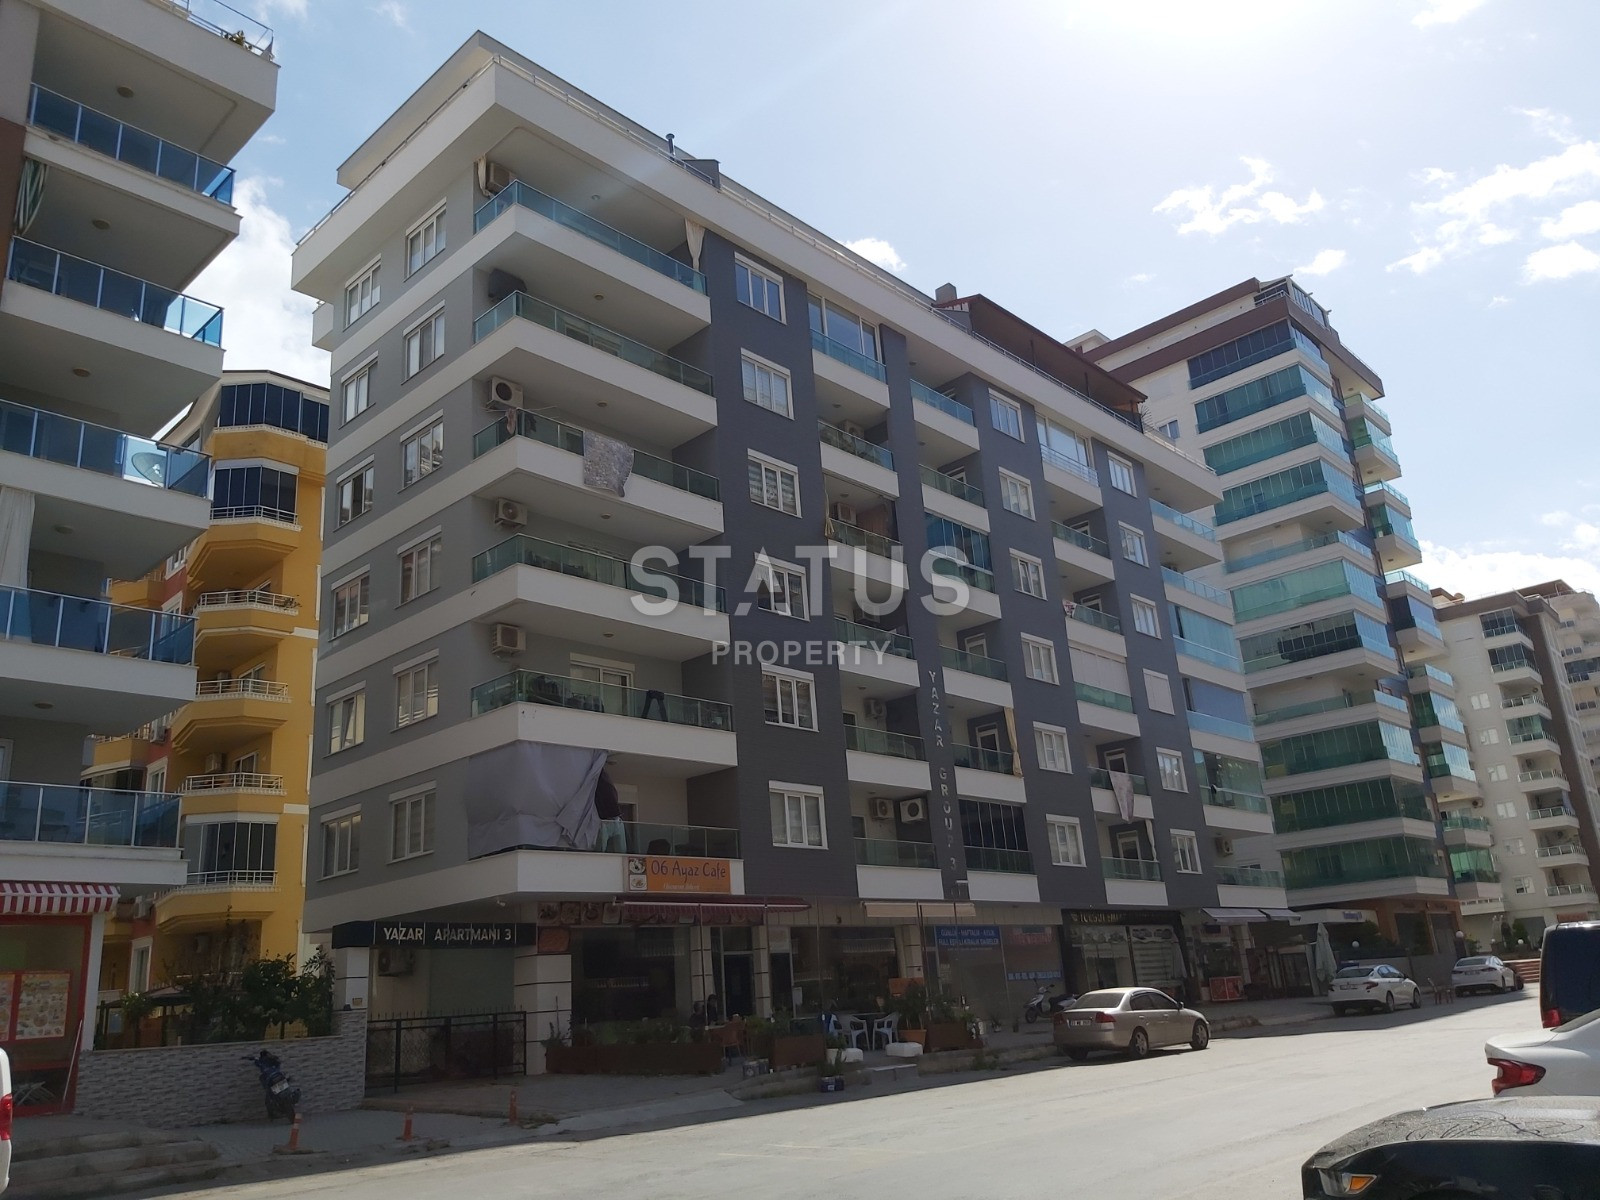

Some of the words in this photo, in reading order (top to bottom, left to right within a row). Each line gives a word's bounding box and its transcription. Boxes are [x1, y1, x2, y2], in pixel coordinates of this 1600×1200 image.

[928, 672, 944, 748] YAZAR
[651, 859, 668, 875] 06
[673, 860, 698, 883] Ayaz
[383, 927, 423, 940] YAZAR
[434, 928, 500, 941] APARTMANI
[504, 928, 512, 940] 3
